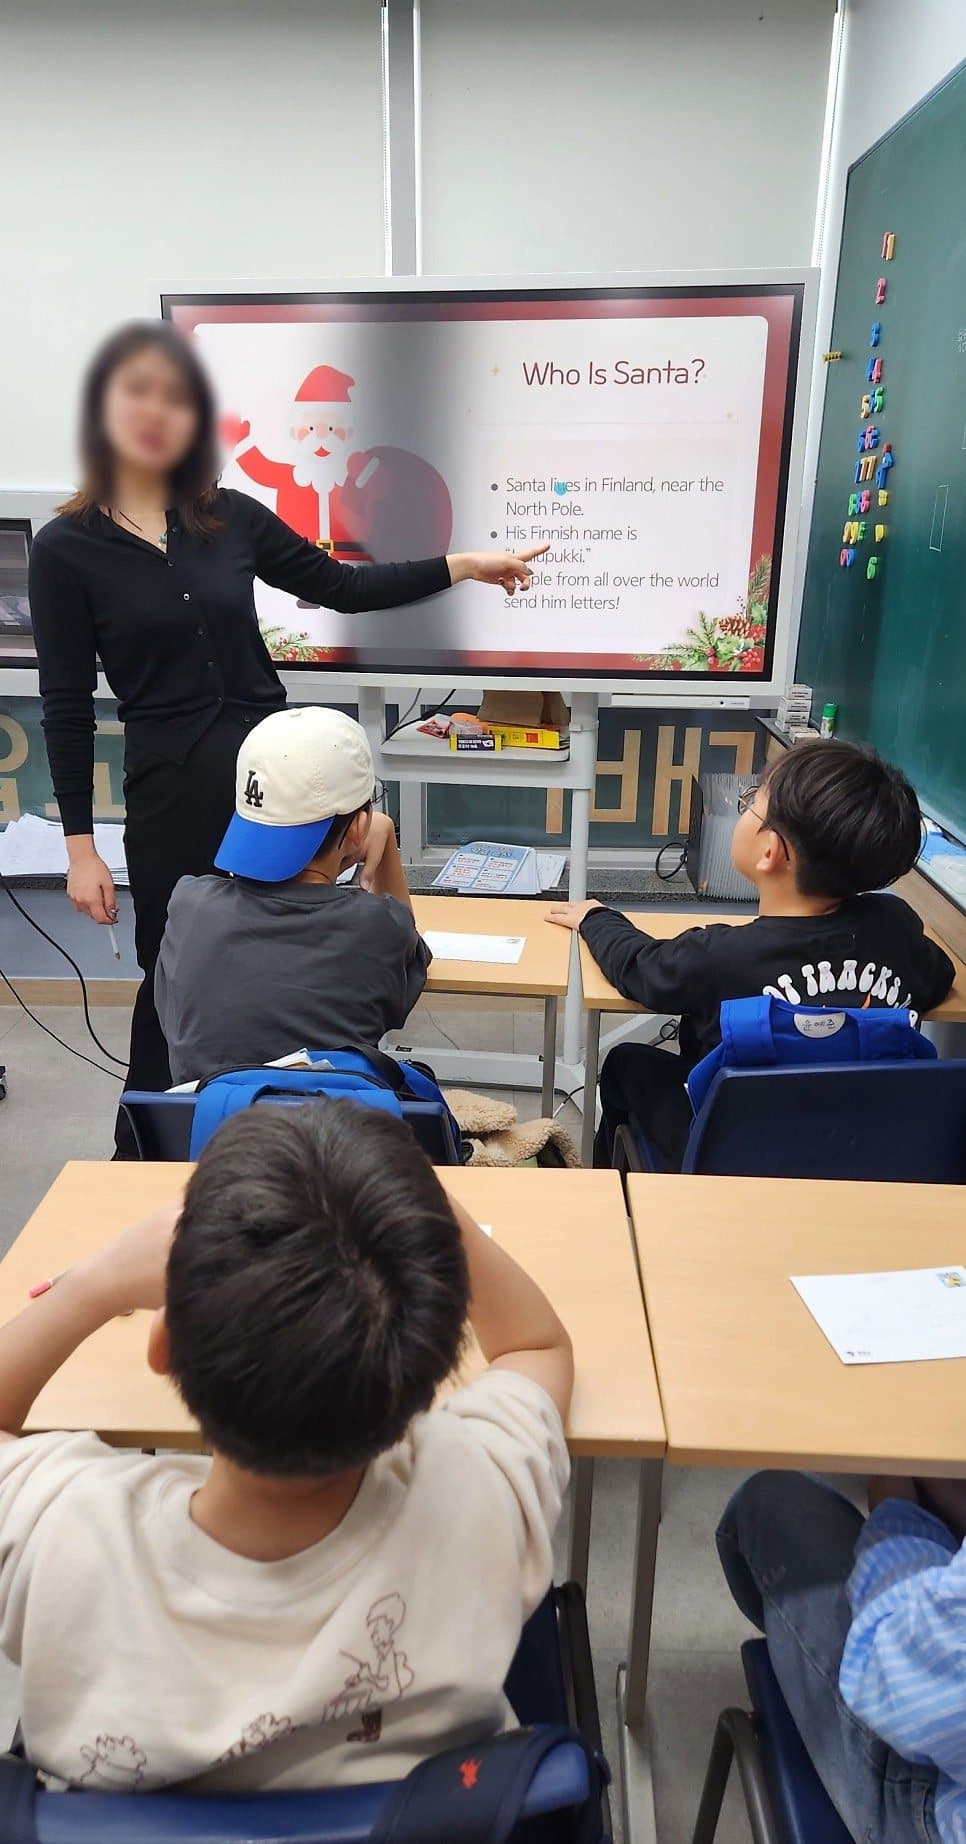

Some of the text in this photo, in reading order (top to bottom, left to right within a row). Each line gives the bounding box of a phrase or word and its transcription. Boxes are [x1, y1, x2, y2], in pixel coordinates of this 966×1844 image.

[522, 358, 706, 386] Who Is Santa?
[506, 477, 724, 495] Santa lives in Finland, near the
[506, 501, 584, 516] North Pole.
[506, 525, 638, 541] His Finnish name is
[556, 571, 590, 586] from
[593, 571, 609, 586] all
[613, 574, 644, 588] over
[649, 572, 674, 588] the
[677, 572, 720, 588] world
[504, 594, 621, 610] send him letters!
[243, 769, 264, 808] LA
